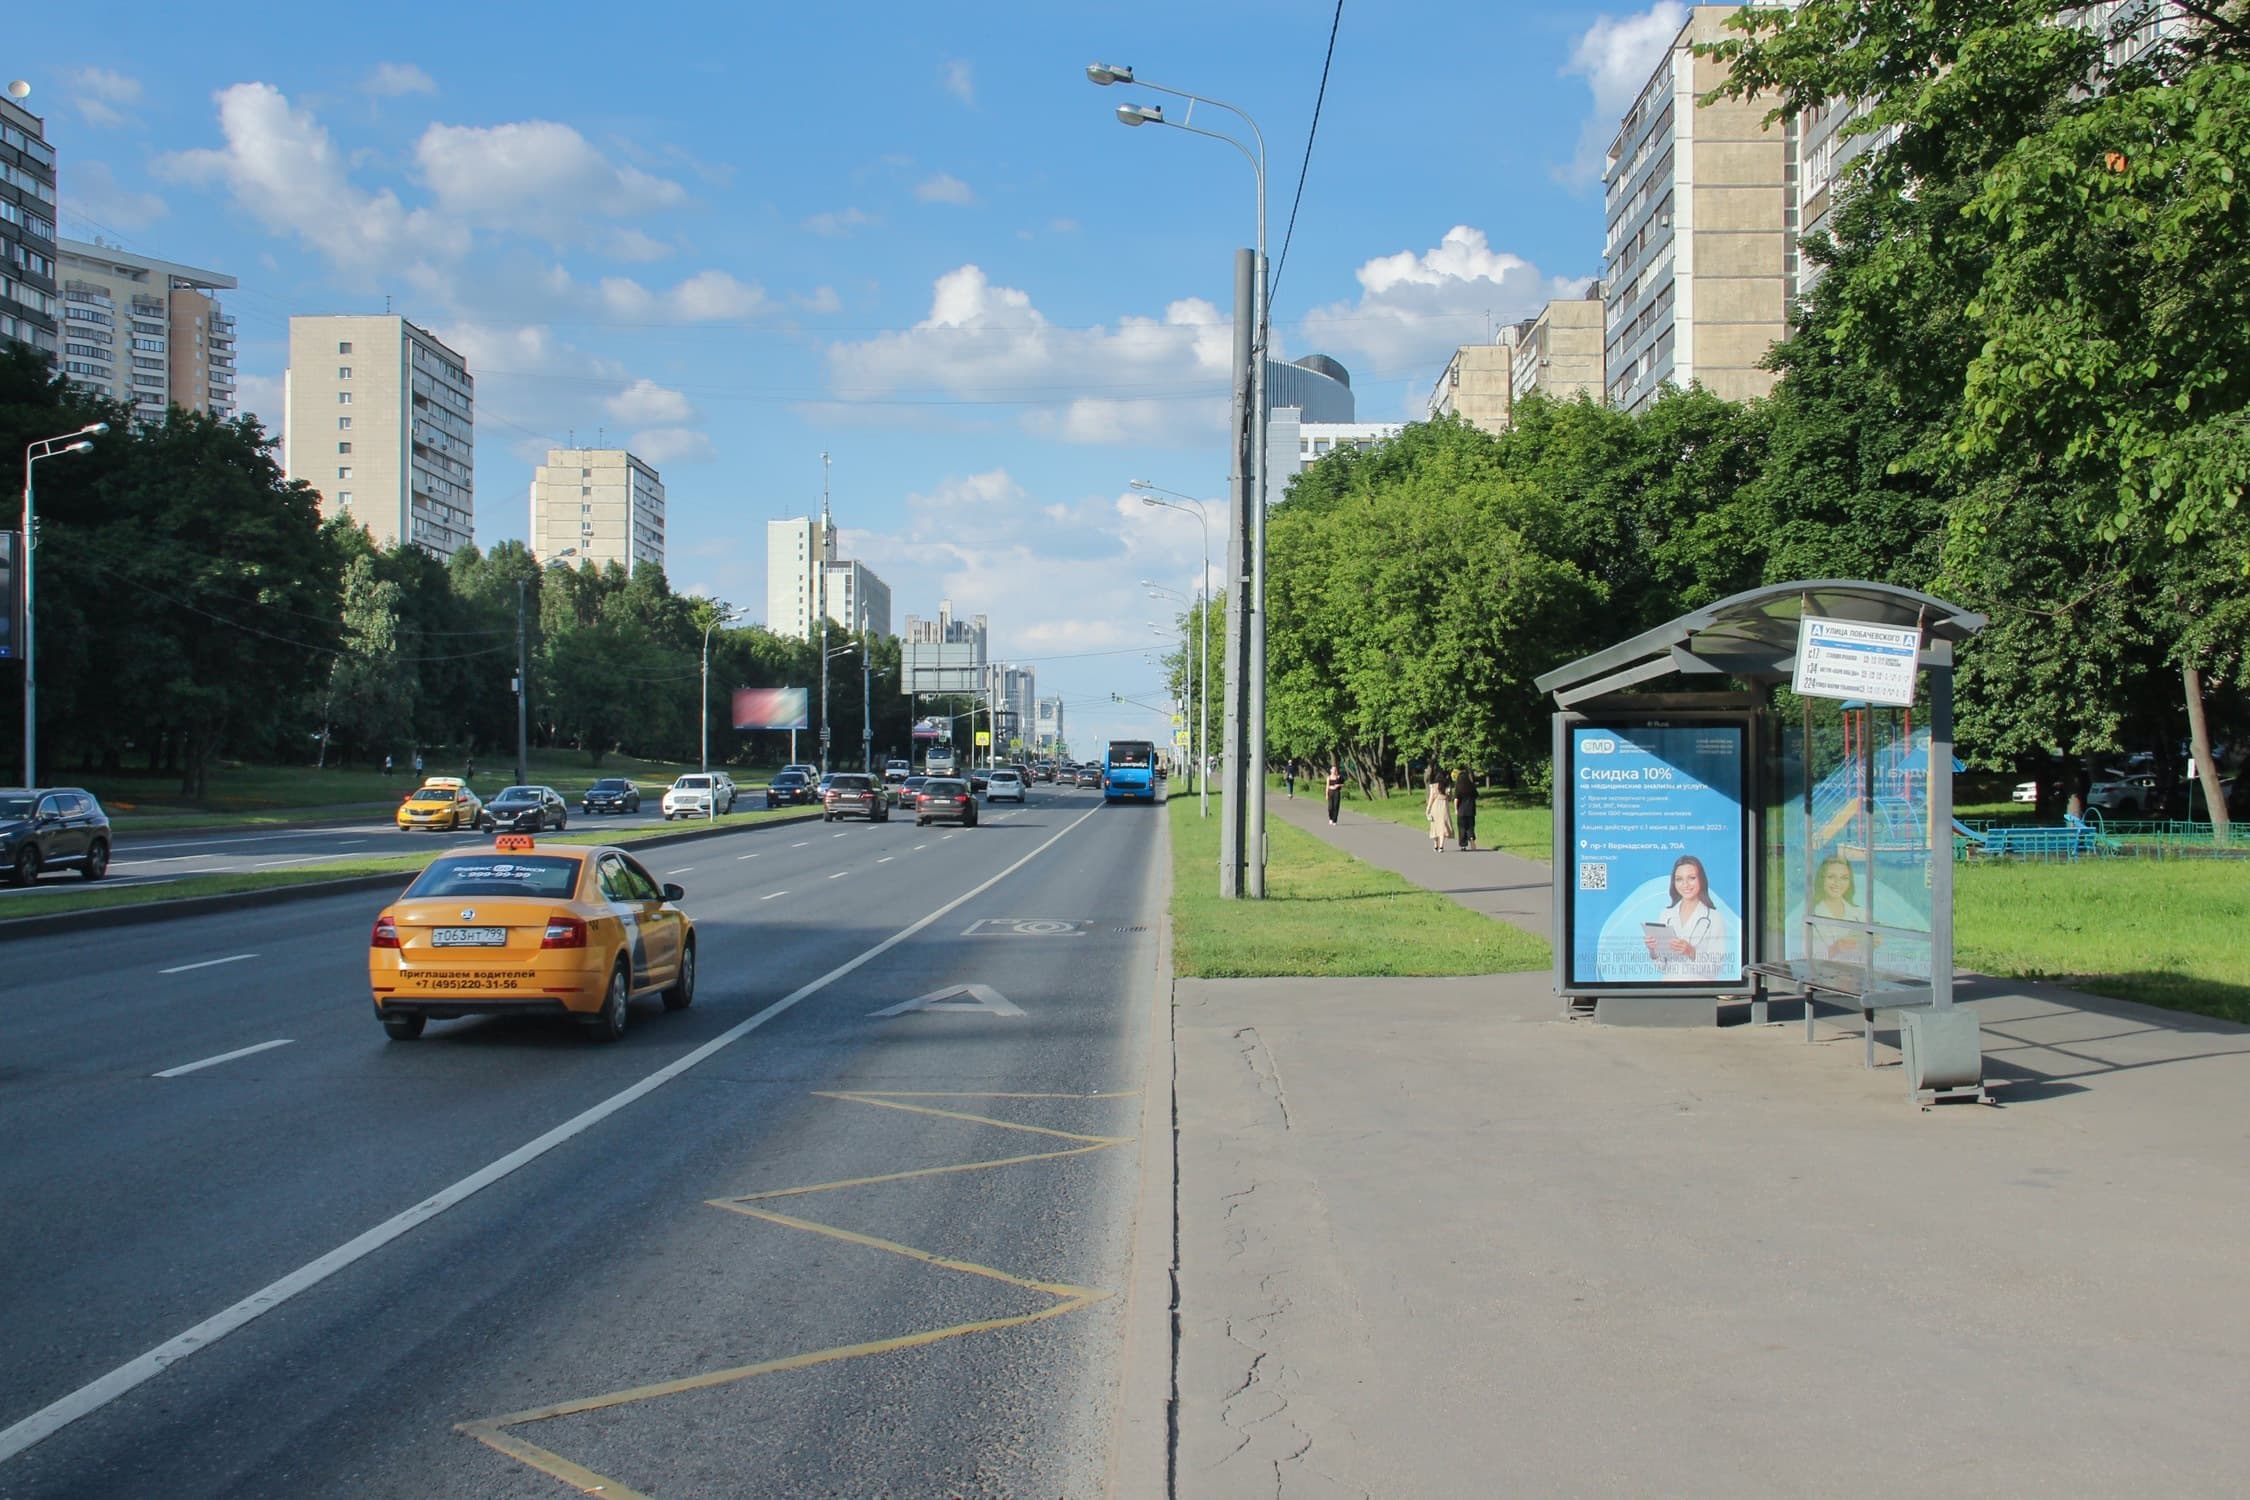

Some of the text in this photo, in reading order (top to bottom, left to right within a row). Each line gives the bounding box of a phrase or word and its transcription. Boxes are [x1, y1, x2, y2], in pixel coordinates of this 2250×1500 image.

[1825, 627, 1848, 637] УЛИЦА
[1849, 630, 1900, 642] ЛОБАЧЕВСКОГО
[1803, 676, 1816, 689] 224
[1580, 767, 1673, 782] Скидка 10%
[1591, 783, 1641, 791] медицинские
[1682, 783, 1708, 792] услуги
[1608, 842, 1659, 850] Вернадского,
[484, 928, 503, 938] 799
[400, 969, 536, 979] Приглашаем водителей
[416, 980, 428, 989] +7
